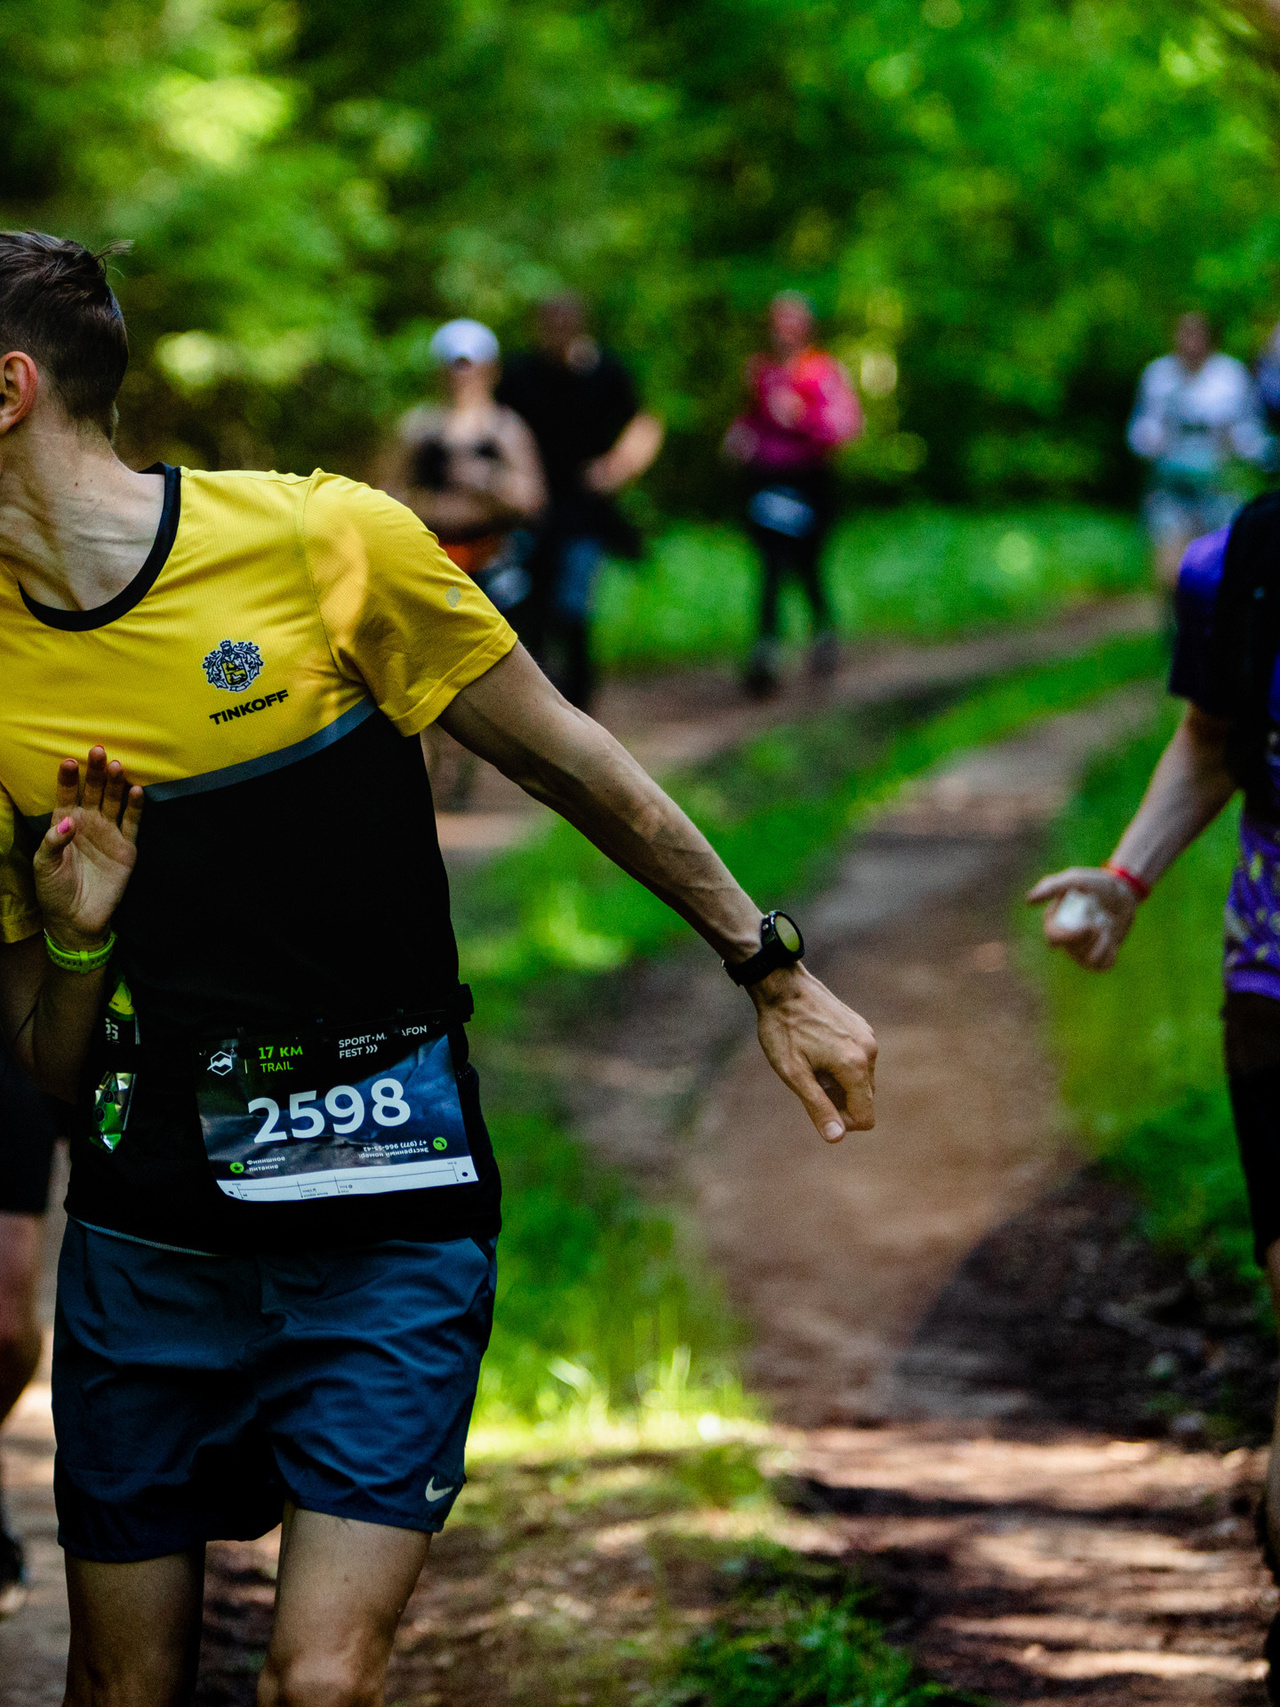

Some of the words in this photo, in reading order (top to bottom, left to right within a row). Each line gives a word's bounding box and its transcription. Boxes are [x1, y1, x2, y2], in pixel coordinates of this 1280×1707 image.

[209, 689, 289, 725] TINKOFF
[258, 1046, 273, 1059] 17
[280, 1045, 303, 1057] KM
[339, 1047, 363, 1059] FEST
[260, 1061, 294, 1073] TRAIL
[247, 1078, 411, 1144] 2598
